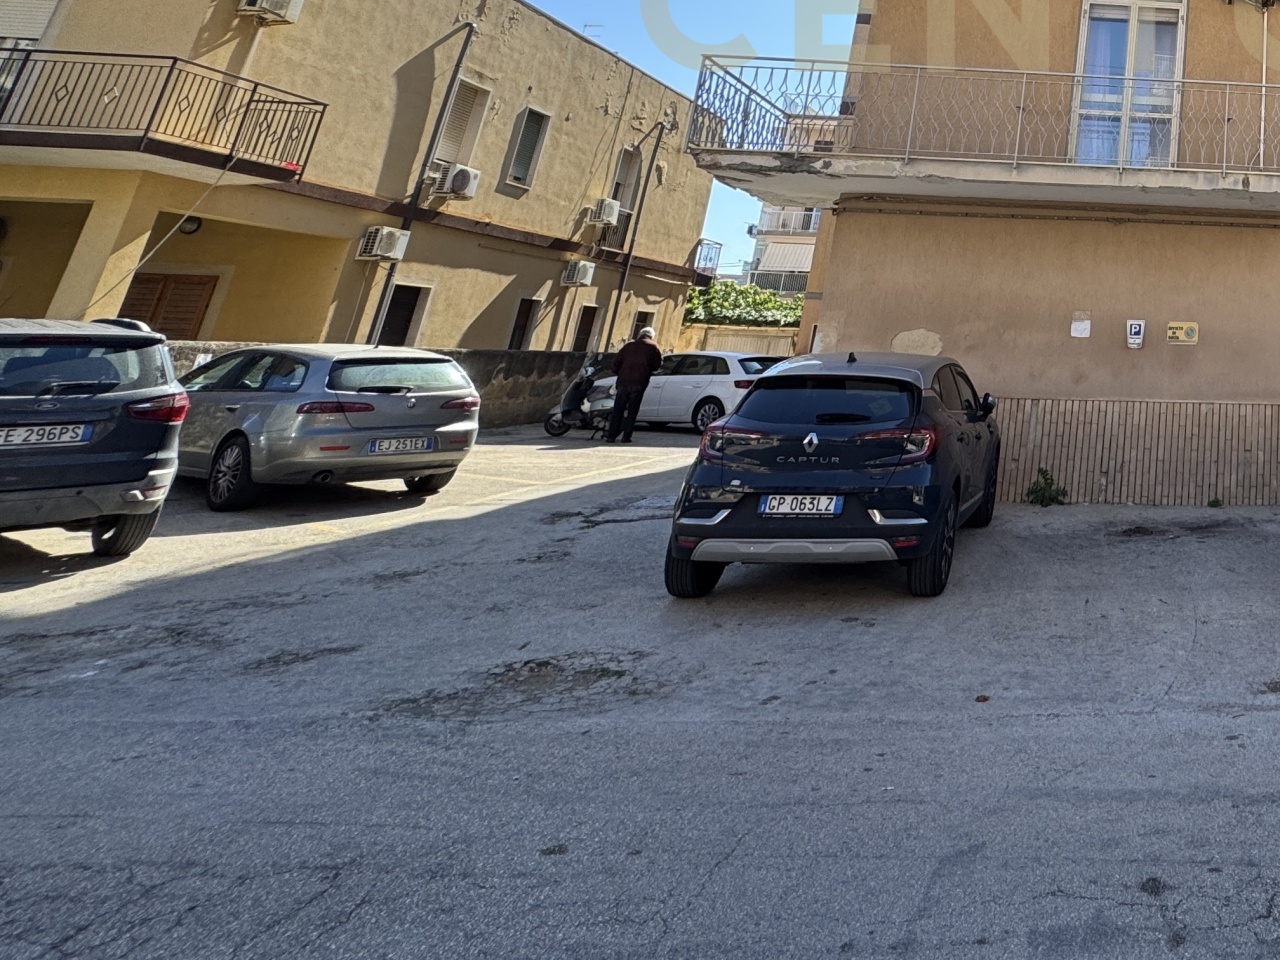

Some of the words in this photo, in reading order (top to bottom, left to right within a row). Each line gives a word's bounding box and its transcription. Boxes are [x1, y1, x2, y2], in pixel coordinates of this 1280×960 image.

[1131, 324, 1140, 335] P
[22, 425, 82, 443] 296PS
[377, 440, 392, 451] EJ
[394, 438, 427, 450] 251EX
[776, 455, 840, 464] CAPTUR
[768, 496, 786, 512] GP
[789, 496, 835, 512] 063LZ
